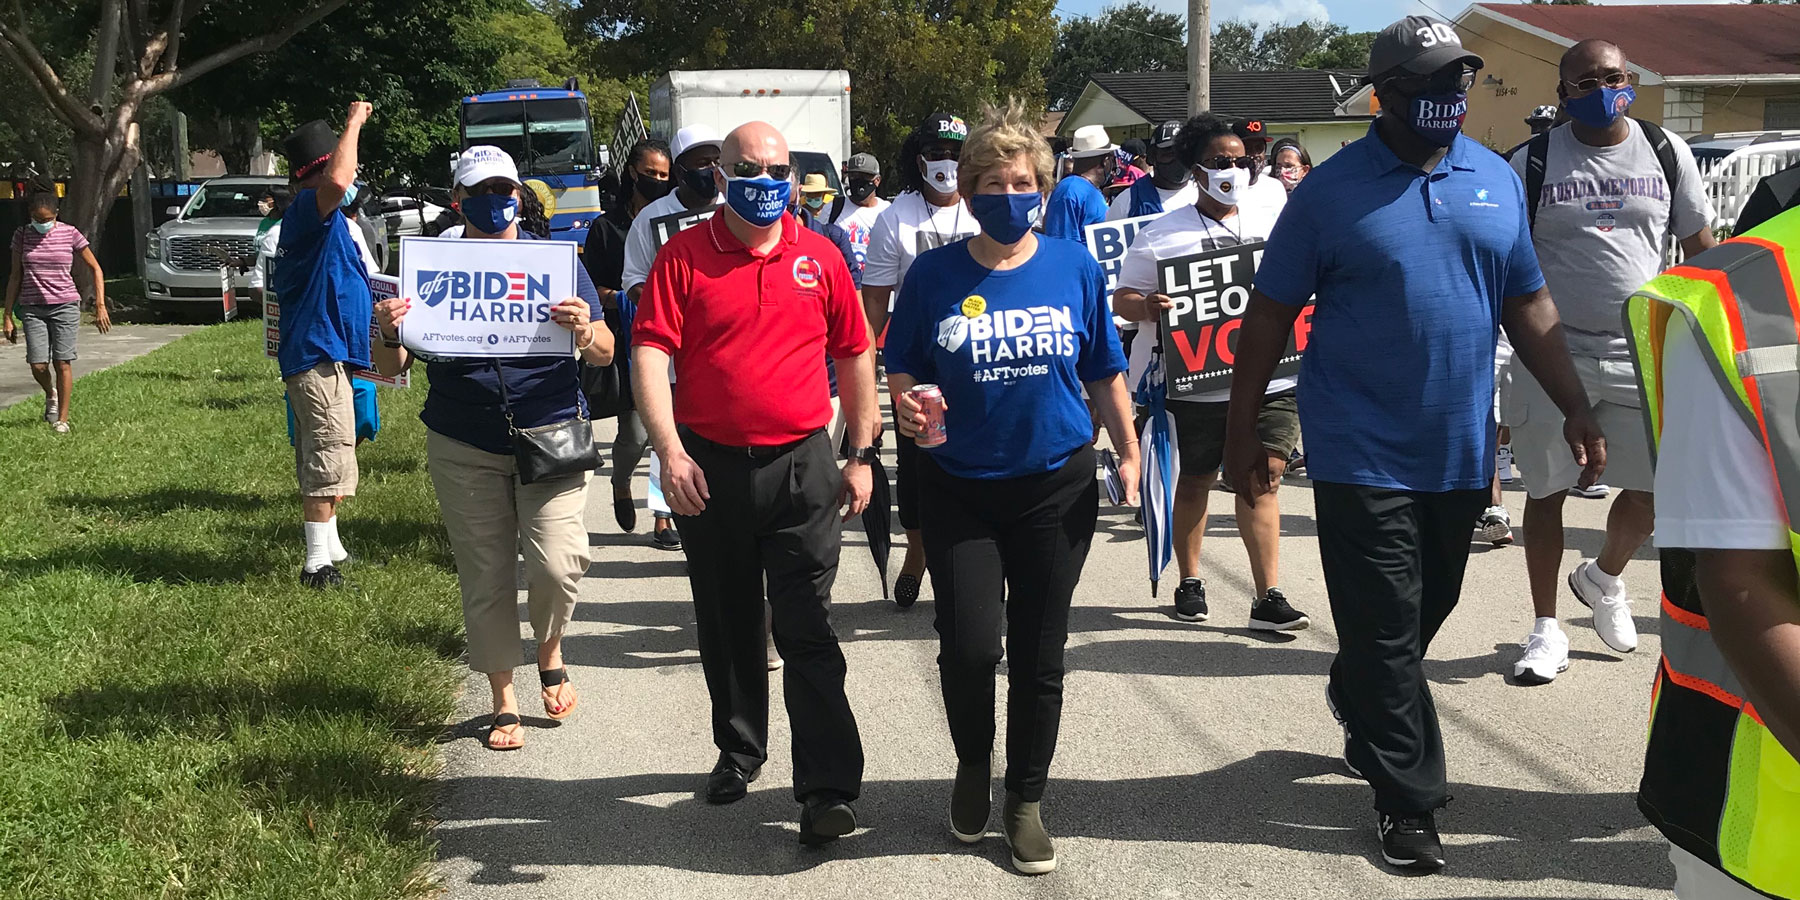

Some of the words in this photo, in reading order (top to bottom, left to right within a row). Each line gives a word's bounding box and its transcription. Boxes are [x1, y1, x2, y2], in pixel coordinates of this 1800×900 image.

[1419, 98, 1467, 120] BIDEN
[611, 129, 624, 168] LET
[621, 100, 634, 137] MY
[938, 119, 968, 136] BOB
[1417, 119, 1457, 129] HARRIS
[938, 131, 965, 141] MARLE
[474, 150, 502, 158] BIDEN
[758, 190, 779, 201] AFT
[1542, 178, 1597, 207] FLORIDA
[1599, 176, 1665, 201] MEMORIAL
[758, 199, 783, 211] votes
[1164, 254, 1239, 294] LET
[419, 270, 455, 301] aft
[450, 271, 550, 301] BIDEN
[450, 301, 550, 323] HARRIS
[1168, 284, 1254, 326] PEO
[970, 306, 1075, 340] BIDEN
[422, 333, 483, 344] AFTvotes.org
[503, 335, 552, 344] #AFTvotes
[971, 332, 1075, 364] HARRIS
[1171, 304, 1317, 373] VOE
[973, 363, 1049, 383] #AFTvotes
